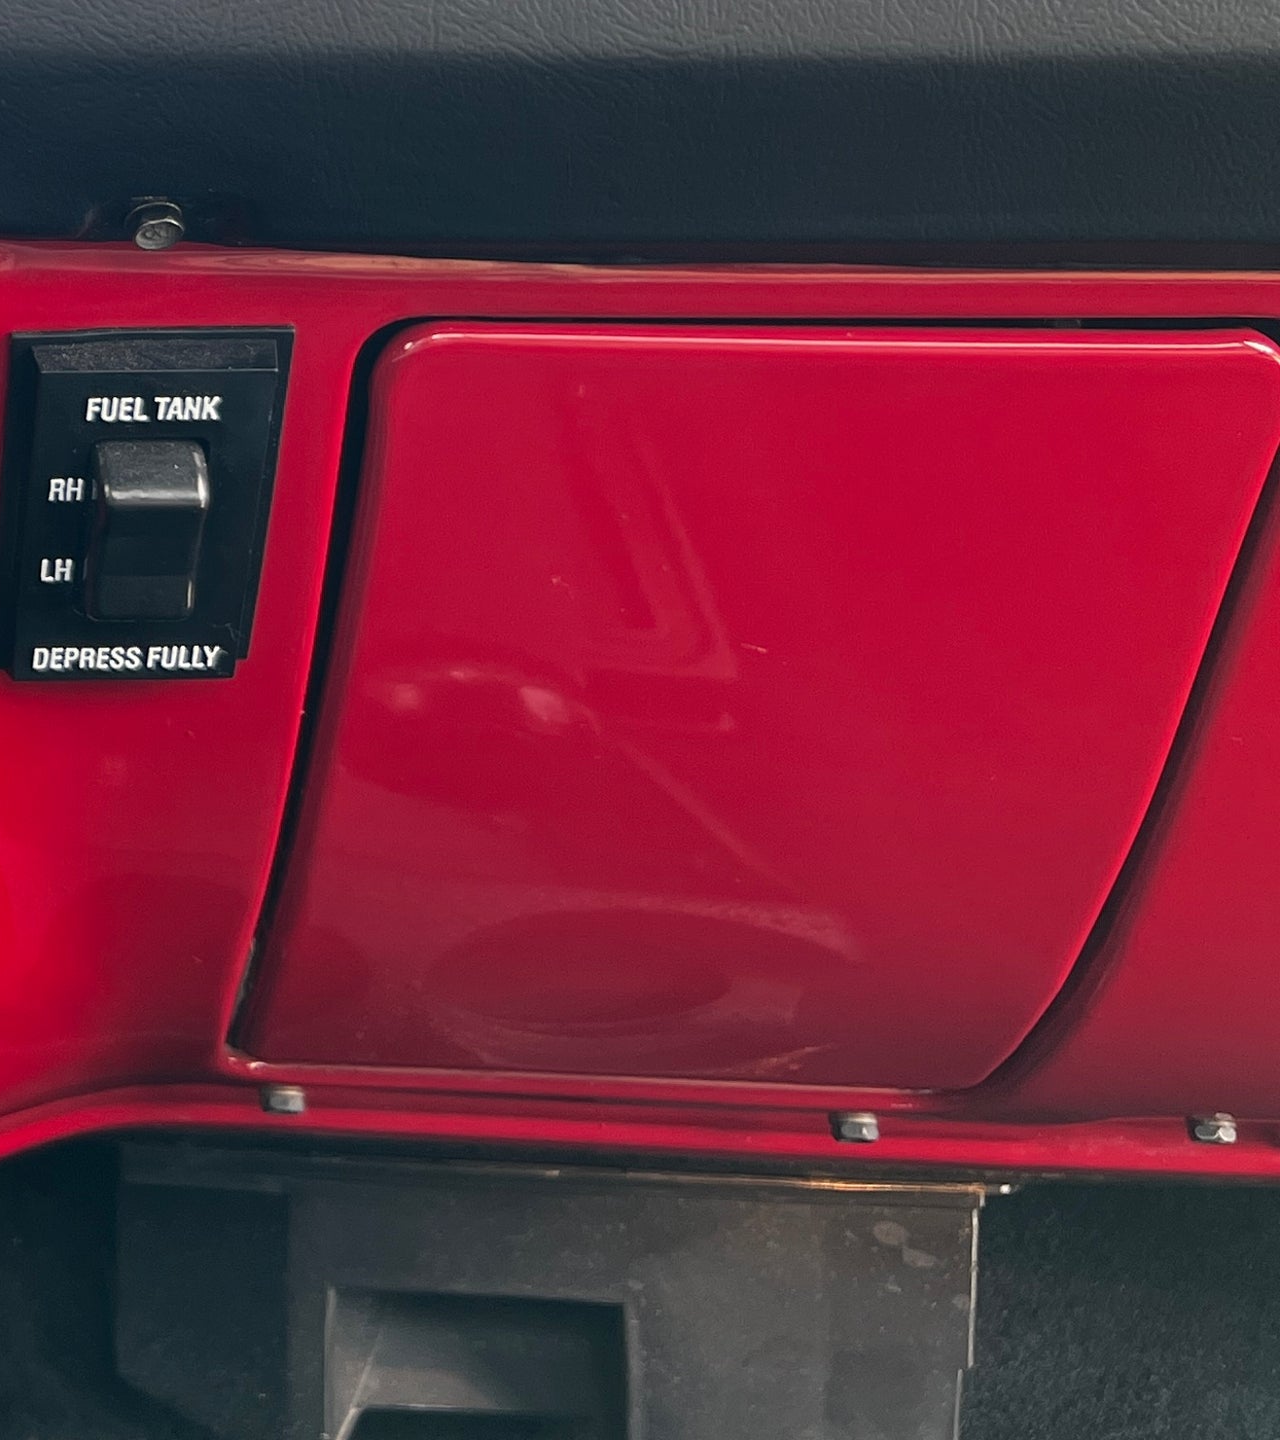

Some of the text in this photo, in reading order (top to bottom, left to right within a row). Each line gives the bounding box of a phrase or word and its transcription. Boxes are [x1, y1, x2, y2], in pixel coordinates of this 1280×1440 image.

[85, 396, 223, 422] FUEL TANK
[48, 477, 85, 502] RH
[40, 558, 73, 582] LH
[32, 645, 223, 671] DEPRESS FULLY
